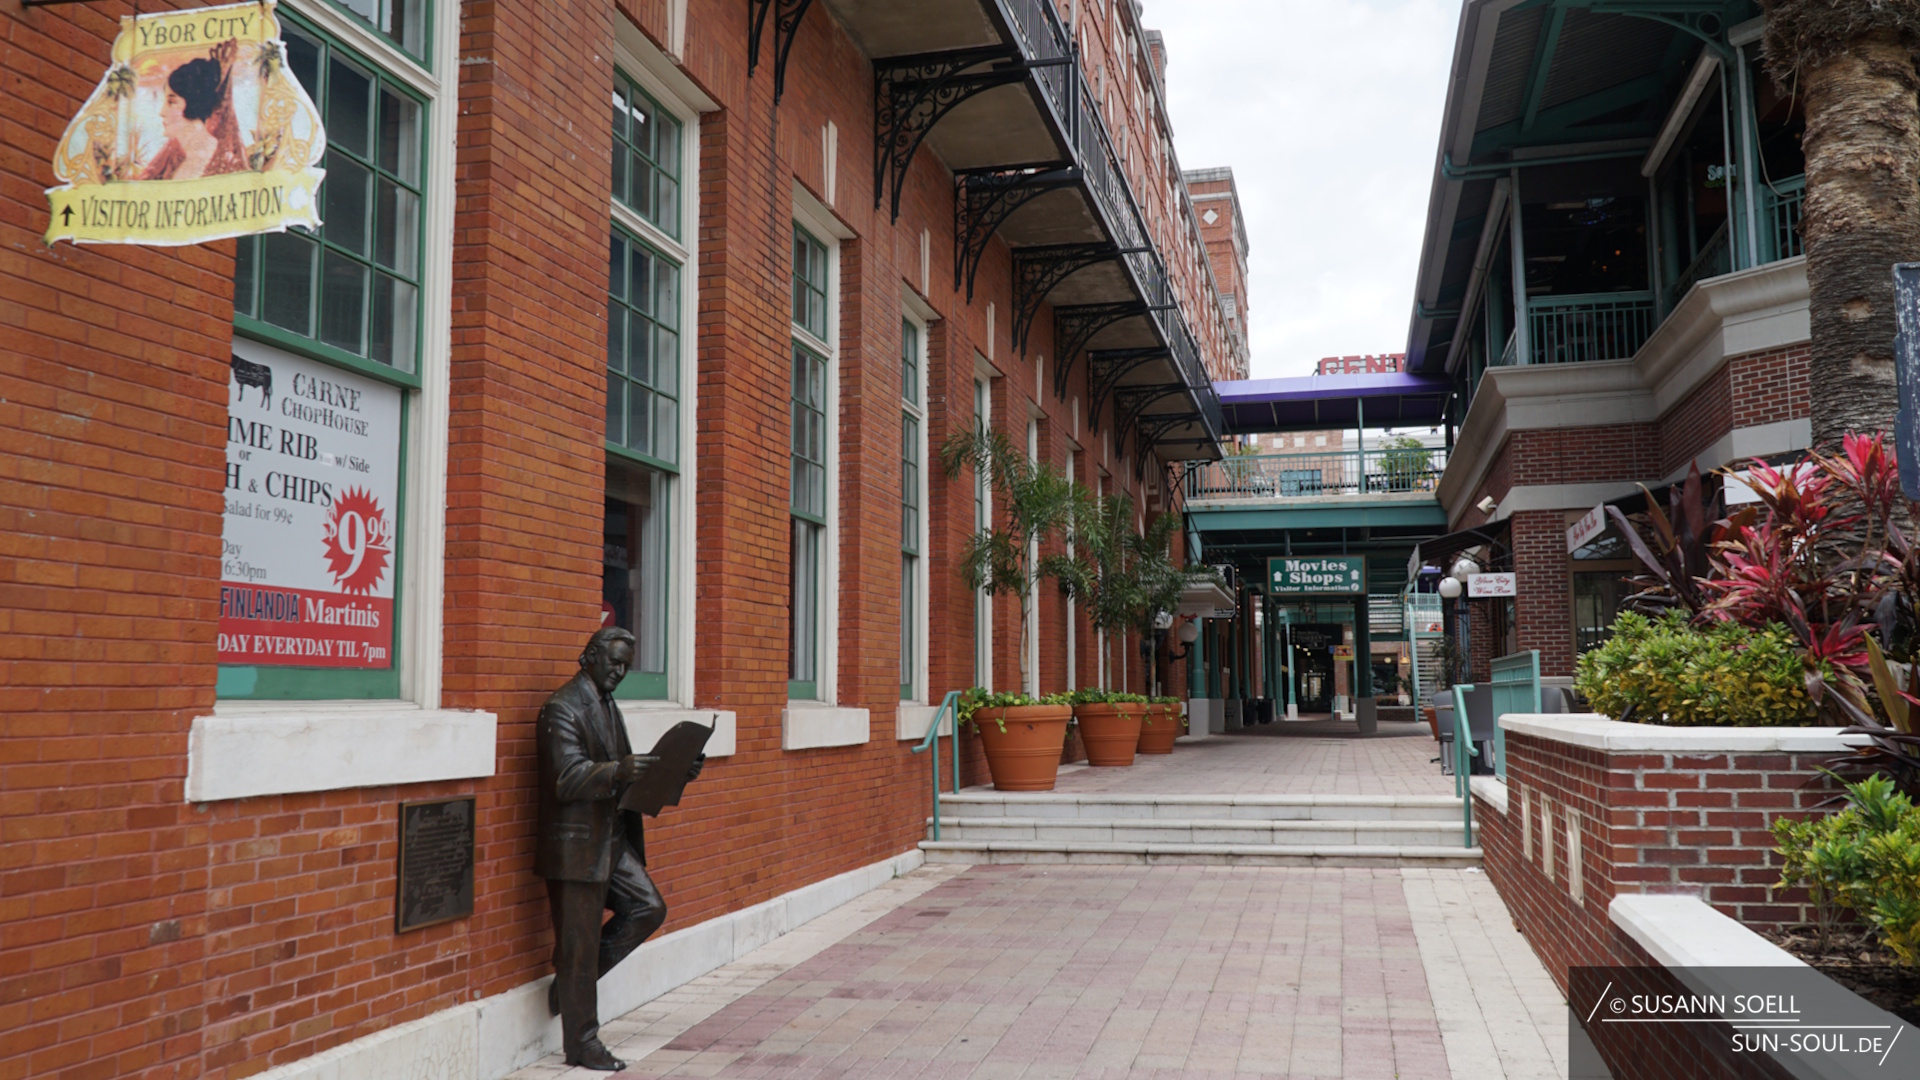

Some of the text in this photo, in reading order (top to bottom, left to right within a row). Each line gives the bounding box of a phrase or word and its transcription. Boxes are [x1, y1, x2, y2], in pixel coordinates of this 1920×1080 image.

[140, 12, 255, 46] YBOR CITY
[81, 185, 284, 229] VISITOR INFORMATION
[292, 372, 361, 413] CARNE
[238, 449, 252, 461] or
[279, 428, 318, 461] RIB
[348, 456, 371, 474] Side
[247, 478, 258, 494] &
[265, 471, 333, 508] CHIPS
[254, 503, 271, 521] for
[1285, 559, 1348, 572] Movies
[1289, 572, 1344, 586] Shops
[220, 586, 380, 629] FINLANDIA Martinis
[253, 634, 334, 658] EVERYDAY
[336, 639, 360, 658] TIL
[362, 641, 387, 663] 7pm
